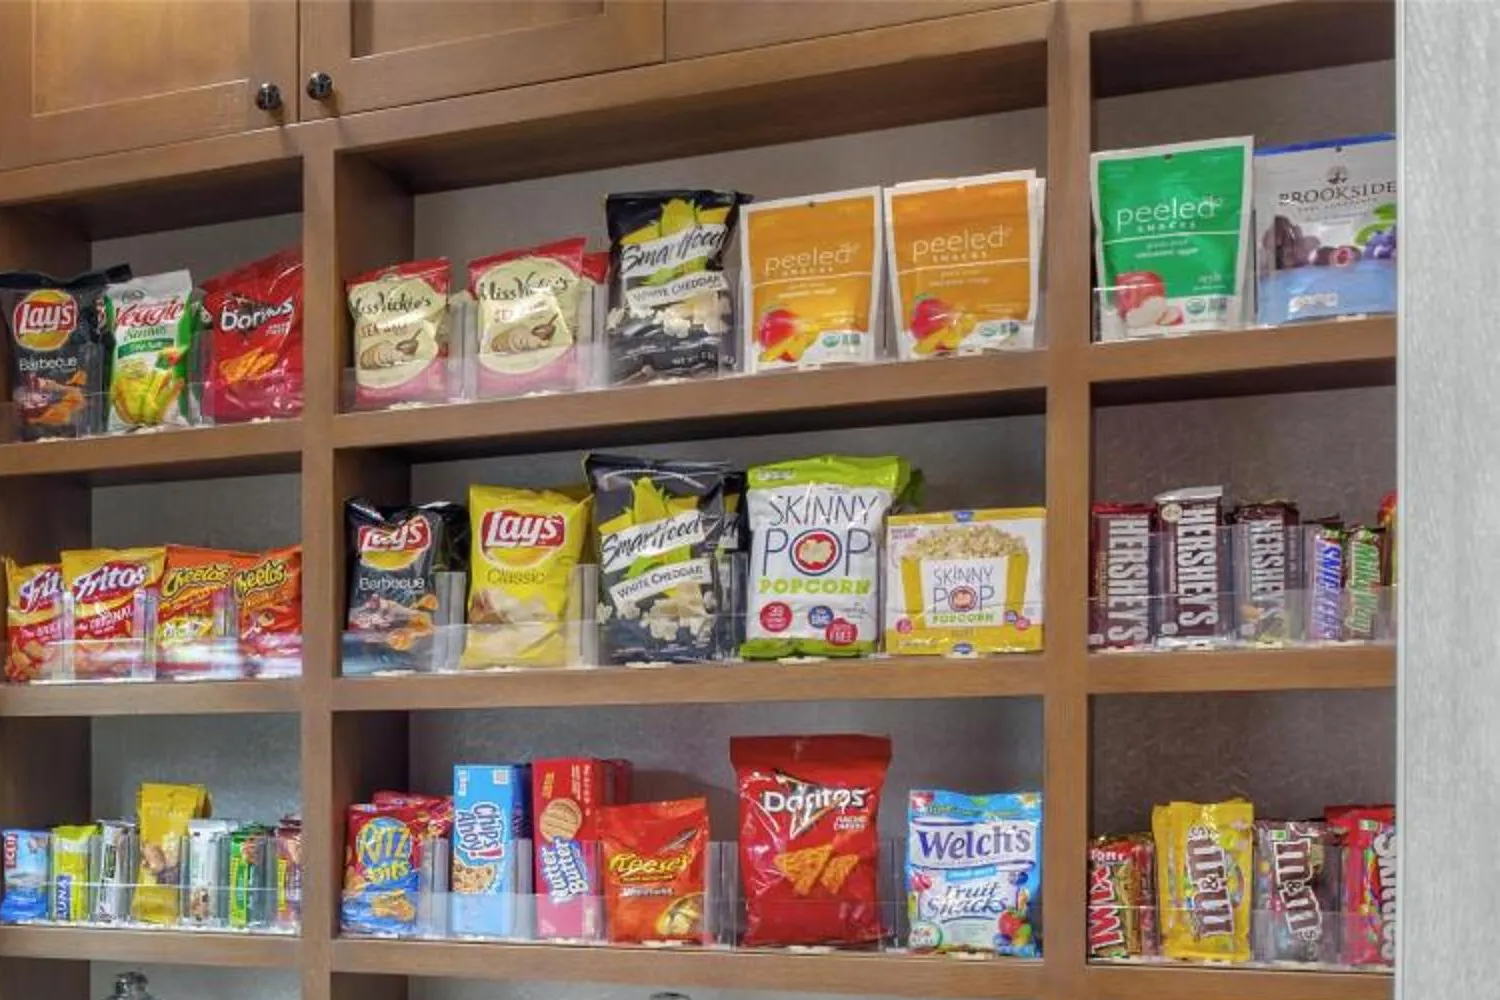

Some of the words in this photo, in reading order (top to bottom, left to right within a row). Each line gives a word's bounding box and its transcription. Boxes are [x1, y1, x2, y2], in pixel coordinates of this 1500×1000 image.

[1279, 181, 1397, 206] BROOKSIDE
[912, 223, 1004, 264] peeled
[19, 355, 77, 372] Barbecue
[767, 493, 878, 528] SKINNY
[602, 516, 701, 572] Smartfood
[762, 527, 873, 577] POP
[486, 569, 546, 586] Classic
[651, 564, 705, 584] CHEDDAR
[933, 565, 995, 587] SKINNY
[1107, 518, 1149, 641] HERSHEY'S
[1177, 505, 1219, 628] HERSHEY'S
[71, 565, 147, 601] Fritos
[359, 576, 425, 592] Barbecue
[757, 576, 870, 595] POPCORN
[932, 585, 996, 614] POP
[763, 788, 868, 814] Doritos
[473, 803, 503, 848] Chips
[915, 825, 1032, 860] Welch's
[541, 846, 573, 905] Nutter
[555, 839, 590, 895] Butter
[945, 881, 1001, 898] Fruit
[926, 897, 1010, 916] Snacks
